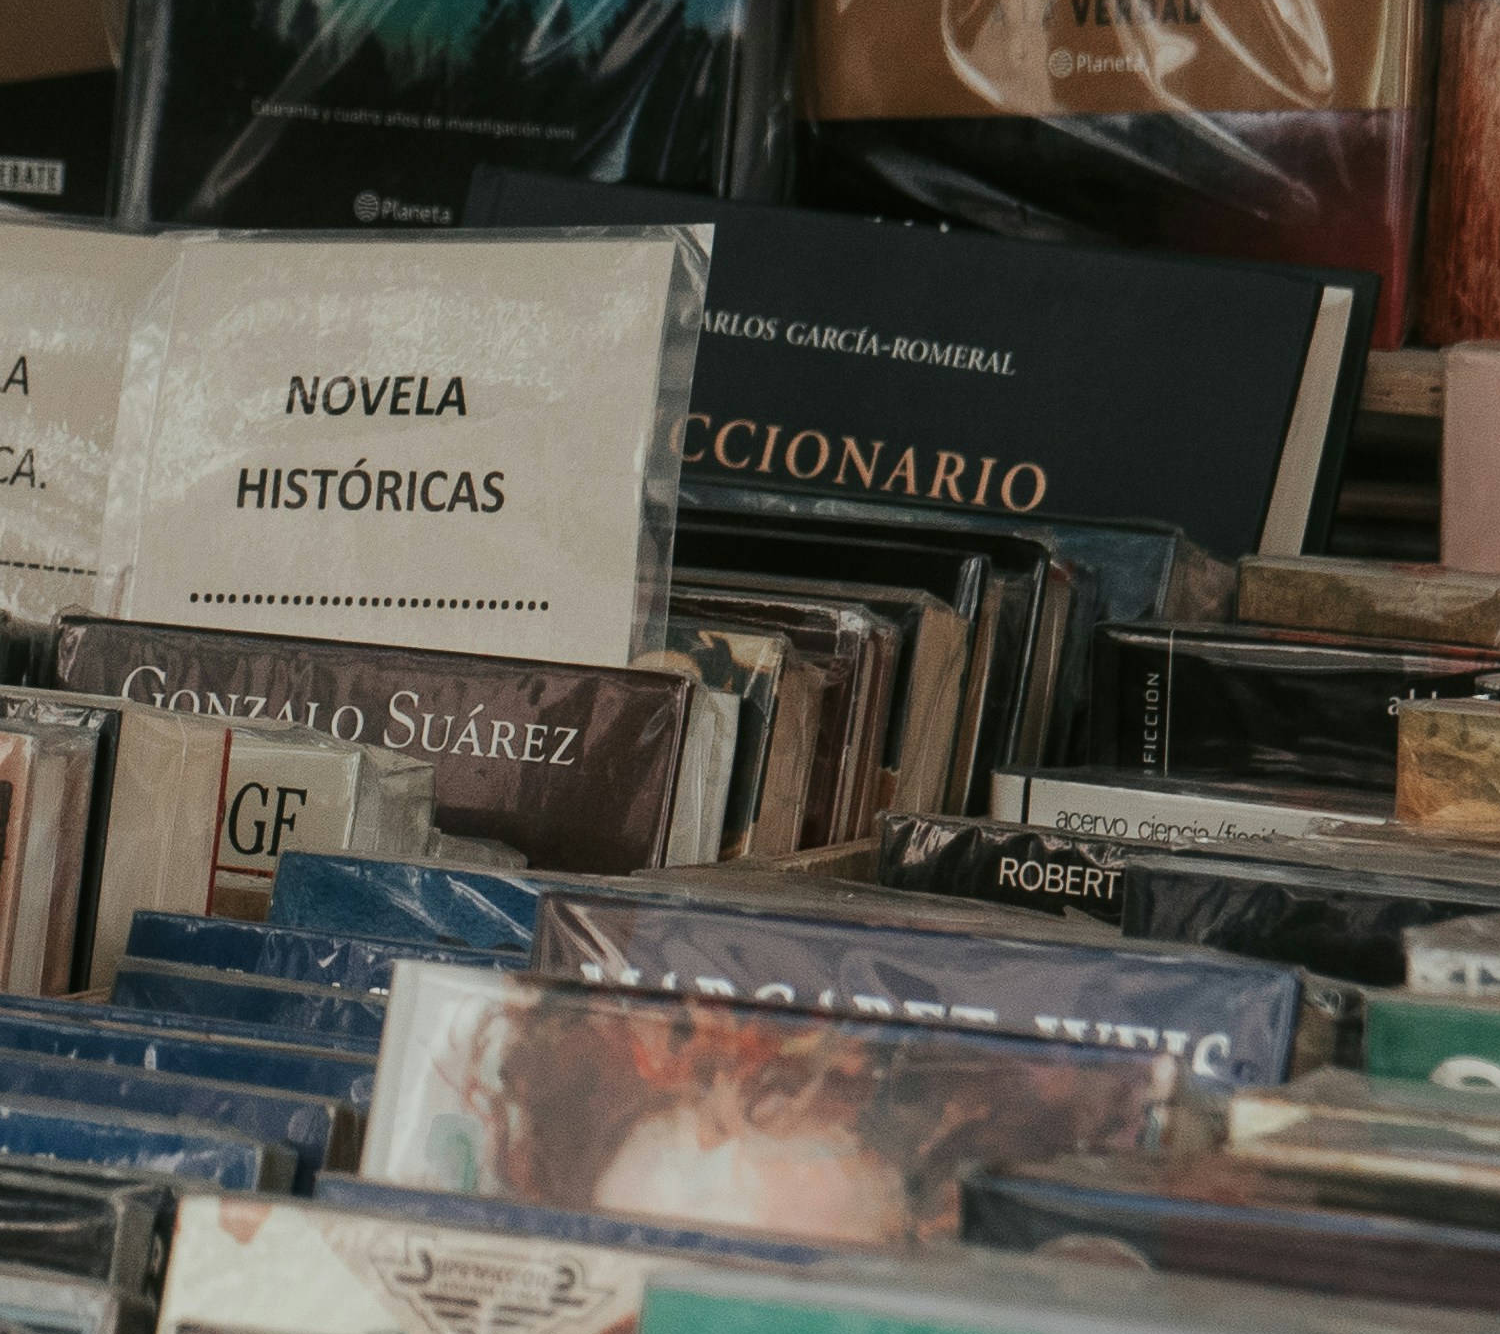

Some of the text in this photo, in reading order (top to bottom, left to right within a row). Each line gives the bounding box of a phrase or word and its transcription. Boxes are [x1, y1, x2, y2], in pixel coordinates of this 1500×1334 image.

[1076, 52, 1146, 75] Planeta
[381, 198, 454, 225] Planeta
[785, 320, 1017, 378] GARCÍA-ROMERAL
[284, 374, 468, 417] NOVELA
[235, 457, 507, 515] HISTÓRICAS
[386, 689, 580, 769] SUÁREZ
[226, 780, 308, 857] GF
[1055, 809, 1128, 837] acervo
[999, 856, 1122, 900] ROBERT
